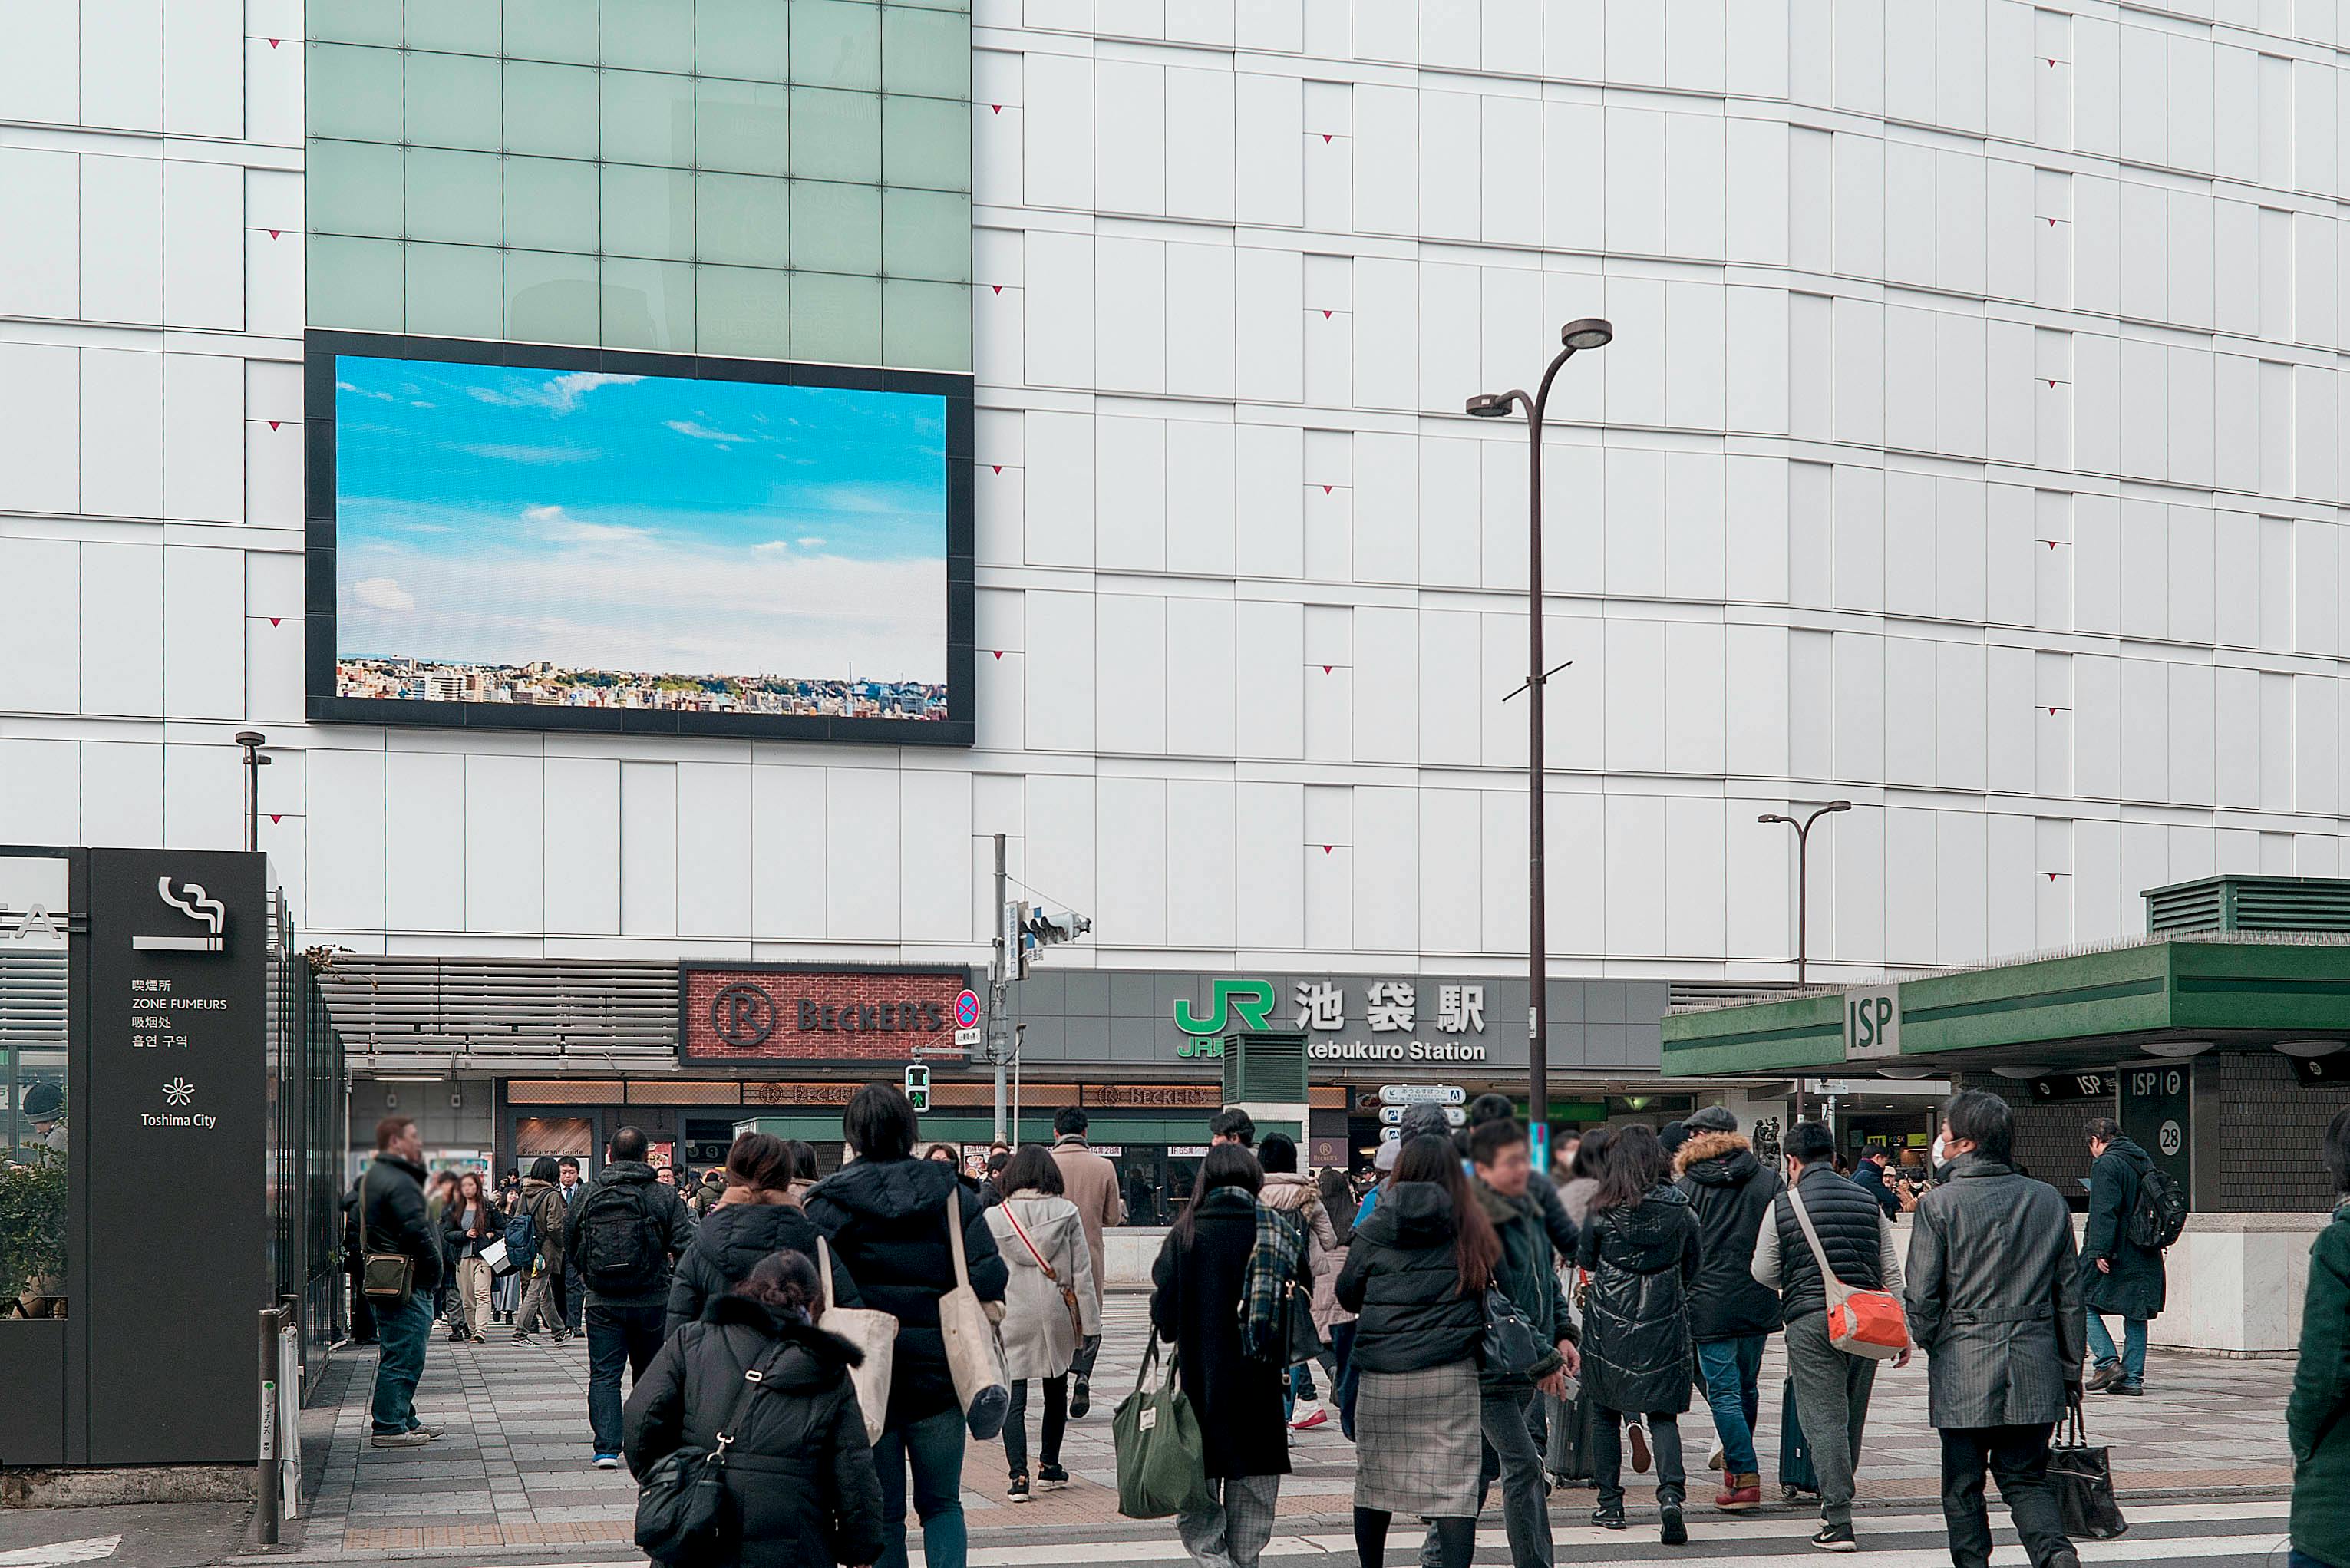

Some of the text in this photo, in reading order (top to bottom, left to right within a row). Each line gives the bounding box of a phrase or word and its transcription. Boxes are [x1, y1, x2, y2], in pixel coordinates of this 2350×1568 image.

[131, 979, 171, 992] 喫煙所
[132, 999, 227, 1010] ZONE FUMEURS
[1174, 979, 1275, 1035] JR
[1294, 981, 1485, 1034] 池袋駅
[131, 1016, 171, 1028] 吸烟处
[797, 999, 942, 1032] BECKER'S
[1850, 997, 1893, 1048] ISP
[162, 1035, 188, 1048] 구역
[1307, 1040, 1486, 1061] kebukuro Station
[2077, 1075, 2101, 1094] ISP
[2132, 1073, 2156, 1095] ISP
[1130, 1087, 1208, 1104] BECKER'S
[141, 1114, 216, 1130] Toshima City
[2162, 1128, 2179, 1148] 28
